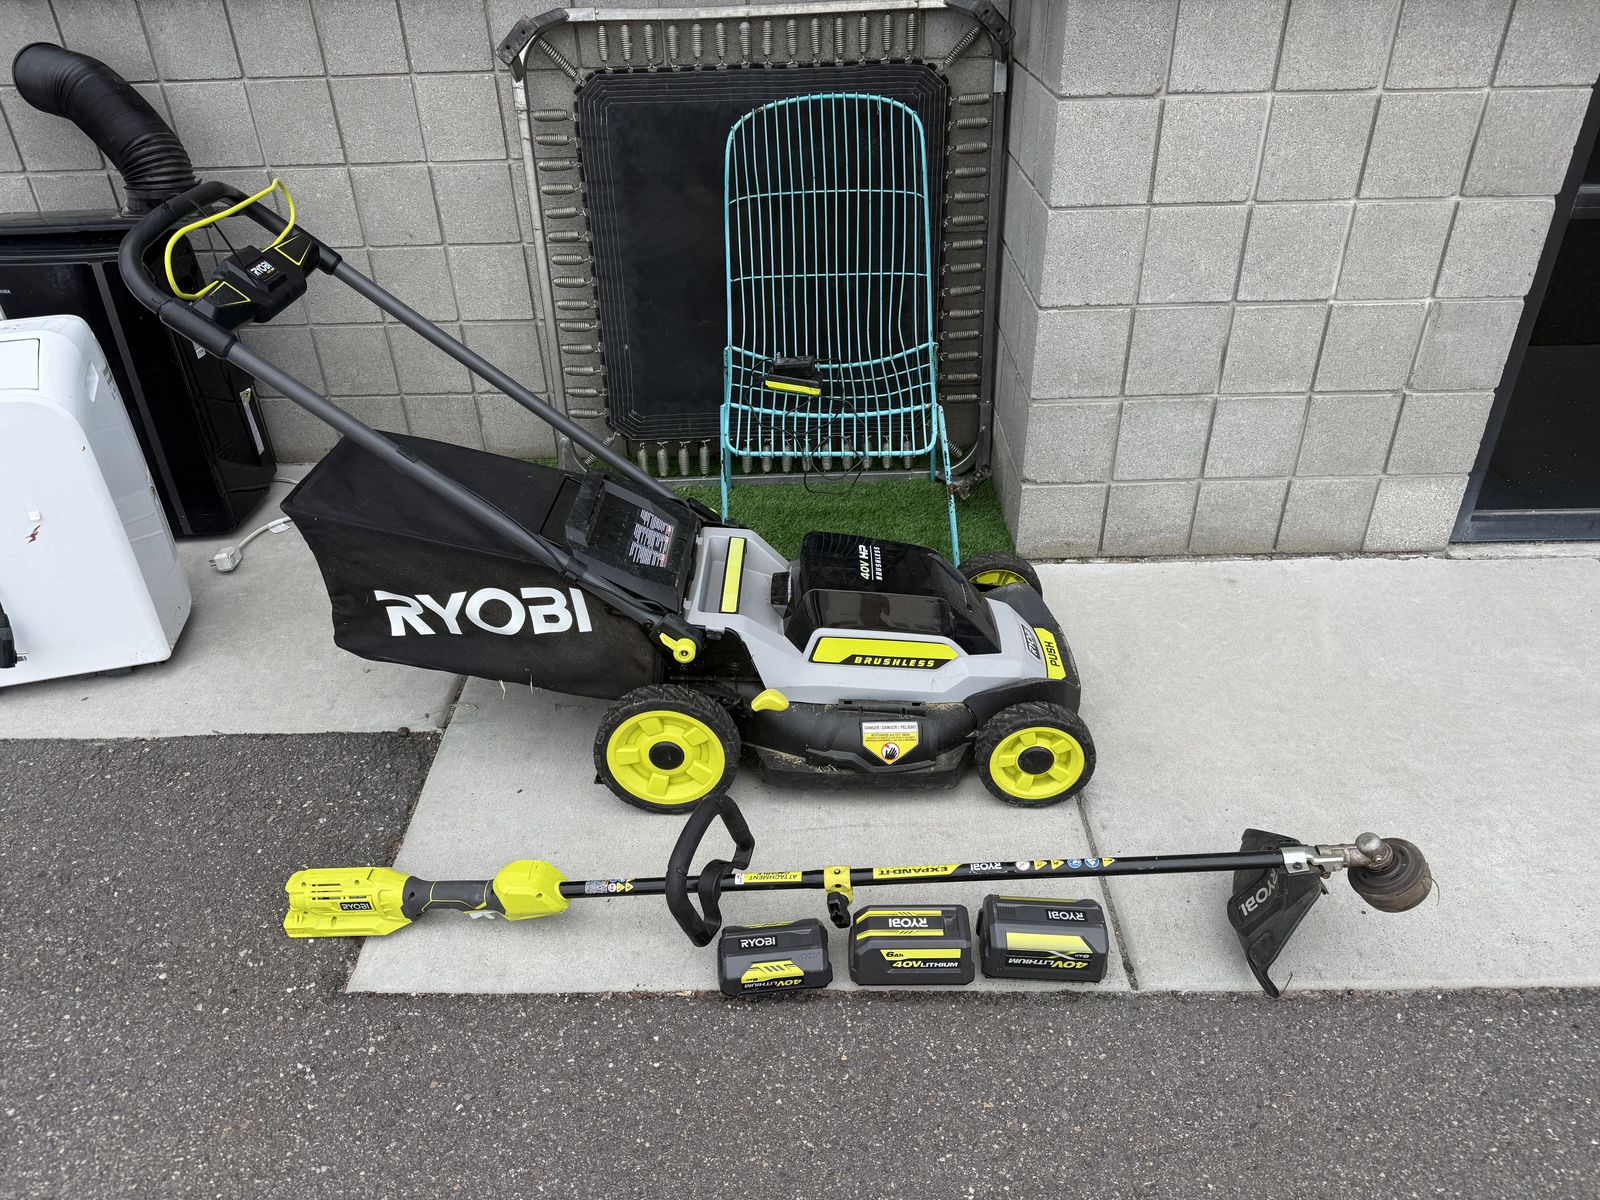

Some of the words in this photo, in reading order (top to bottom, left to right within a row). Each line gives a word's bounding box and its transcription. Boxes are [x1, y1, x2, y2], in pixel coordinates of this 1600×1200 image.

[859, 544, 869, 560] HP
[860, 560, 870, 580] 40V
[873, 546, 883, 580] BRUSHLESS
[373, 587, 593, 637] RYOBI
[1044, 641, 1060, 667] PUSH
[854, 656, 935, 668] BRUSHLESS
[970, 862, 1003, 871] RYOBI
[1048, 910, 1085, 921] RYOBI
[889, 918, 928, 928] RYOBI
[740, 937, 776, 948] RYOBI
